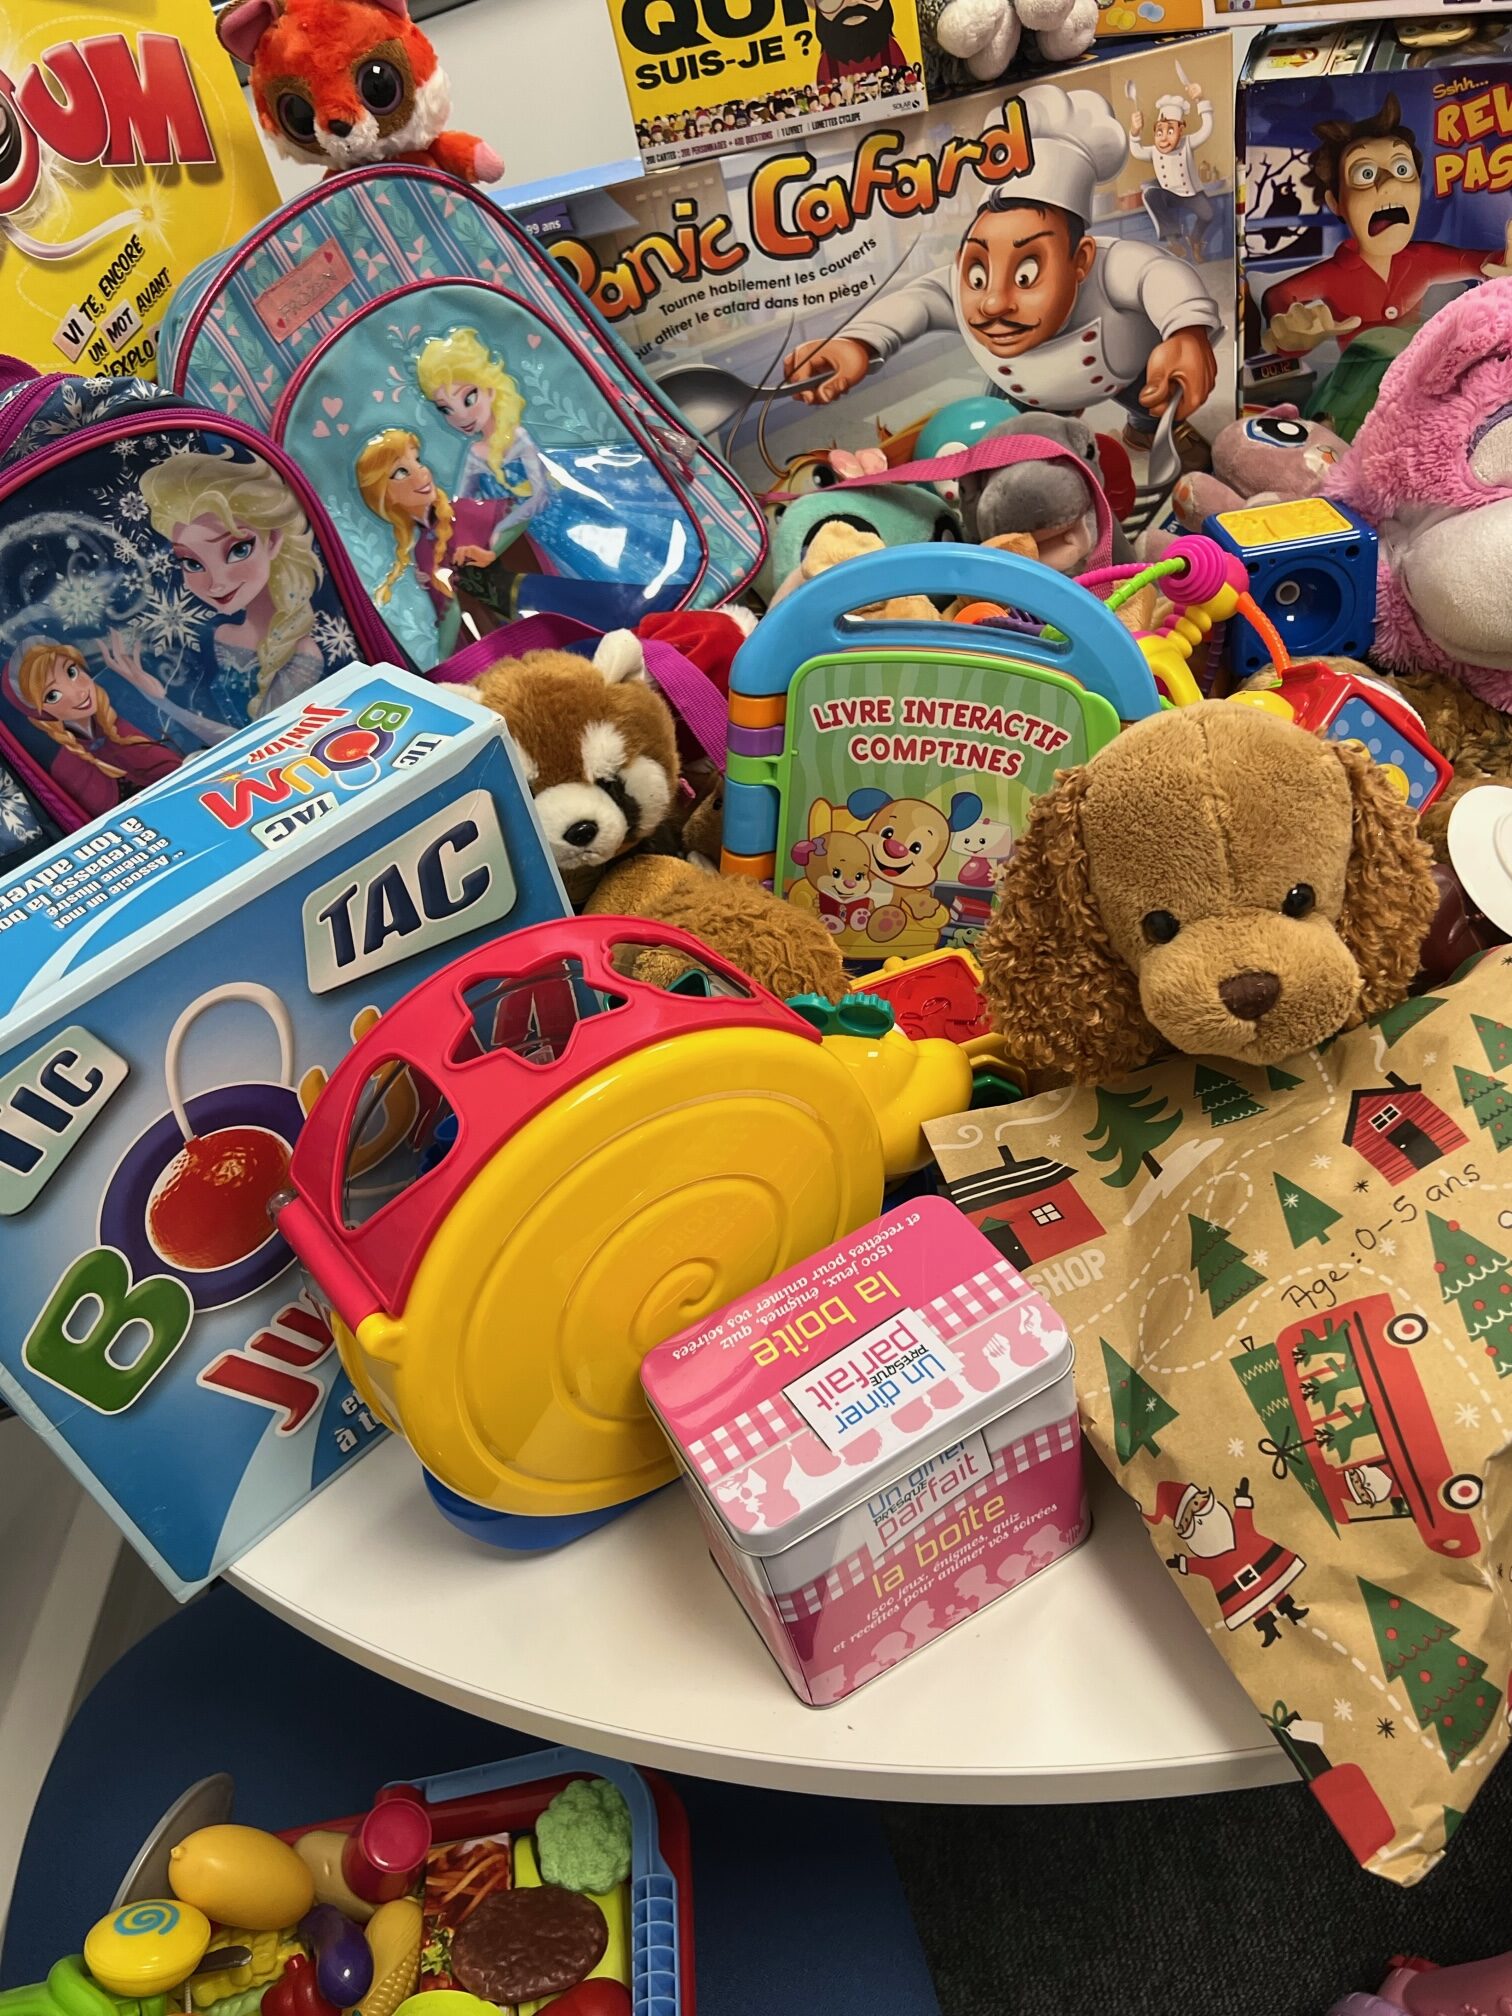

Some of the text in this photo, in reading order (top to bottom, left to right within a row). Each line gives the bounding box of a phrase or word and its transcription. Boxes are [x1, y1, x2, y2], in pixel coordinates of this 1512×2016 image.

[635, 36, 785, 90] SUIS-JE
[1433, 77, 1489, 99] Sshh...
[748, 97, 1036, 261] Cafard
[541, 219, 562, 232] ans
[98, 234, 145, 301] ENCORE
[659, 239, 877, 317] Tourne habilement les couverts
[87, 267, 172, 364] UN MOT AVANT
[655, 318, 694, 346] attirer
[697, 310, 710, 324] le
[714, 298, 760, 318] cafard
[765, 297, 799, 311] dans
[803, 291, 824, 306] ton
[829, 281, 869, 304] piège
[400, 738, 443, 768] TIC
[813, 699, 1069, 752] LIVRE INTERACTIF
[849, 736, 1023, 777] COMPTINES
[200, 701, 413, 830] BOUM
[149, 838, 170, 854] au
[264, 799, 334, 843] TAC
[0, 817, 145, 912] à ton adver
[0, 829, 158, 934] et repasse la bo
[100, 851, 150, 883] thème
[319, 820, 490, 968] TAC
[53, 905, 88, 930] mot
[86, 892, 110, 908] un
[1426, 1163, 1481, 1202] ans
[671, 1212, 921, 1361] et recettes pour animer vos soirées
[719, 1244, 894, 1351] 1500 jeux, énigmes, quiz
[748, 1270, 901, 1367] la boîte
[804, 1319, 919, 1411] parfait
[834, 1353, 946, 1434] Un dîner
[869, 1344, 930, 1387] PRESQUE
[867, 1486, 902, 1519] Un
[873, 1479, 928, 1527] PRESQUE
[877, 1453, 979, 1548] parfait
[832, 1503, 1058, 1653] et recettes pour animer vos soirées
[867, 1511, 1021, 1621] 1500 jeux, énigmes, quiz
[872, 1495, 1006, 1599] la boîte
